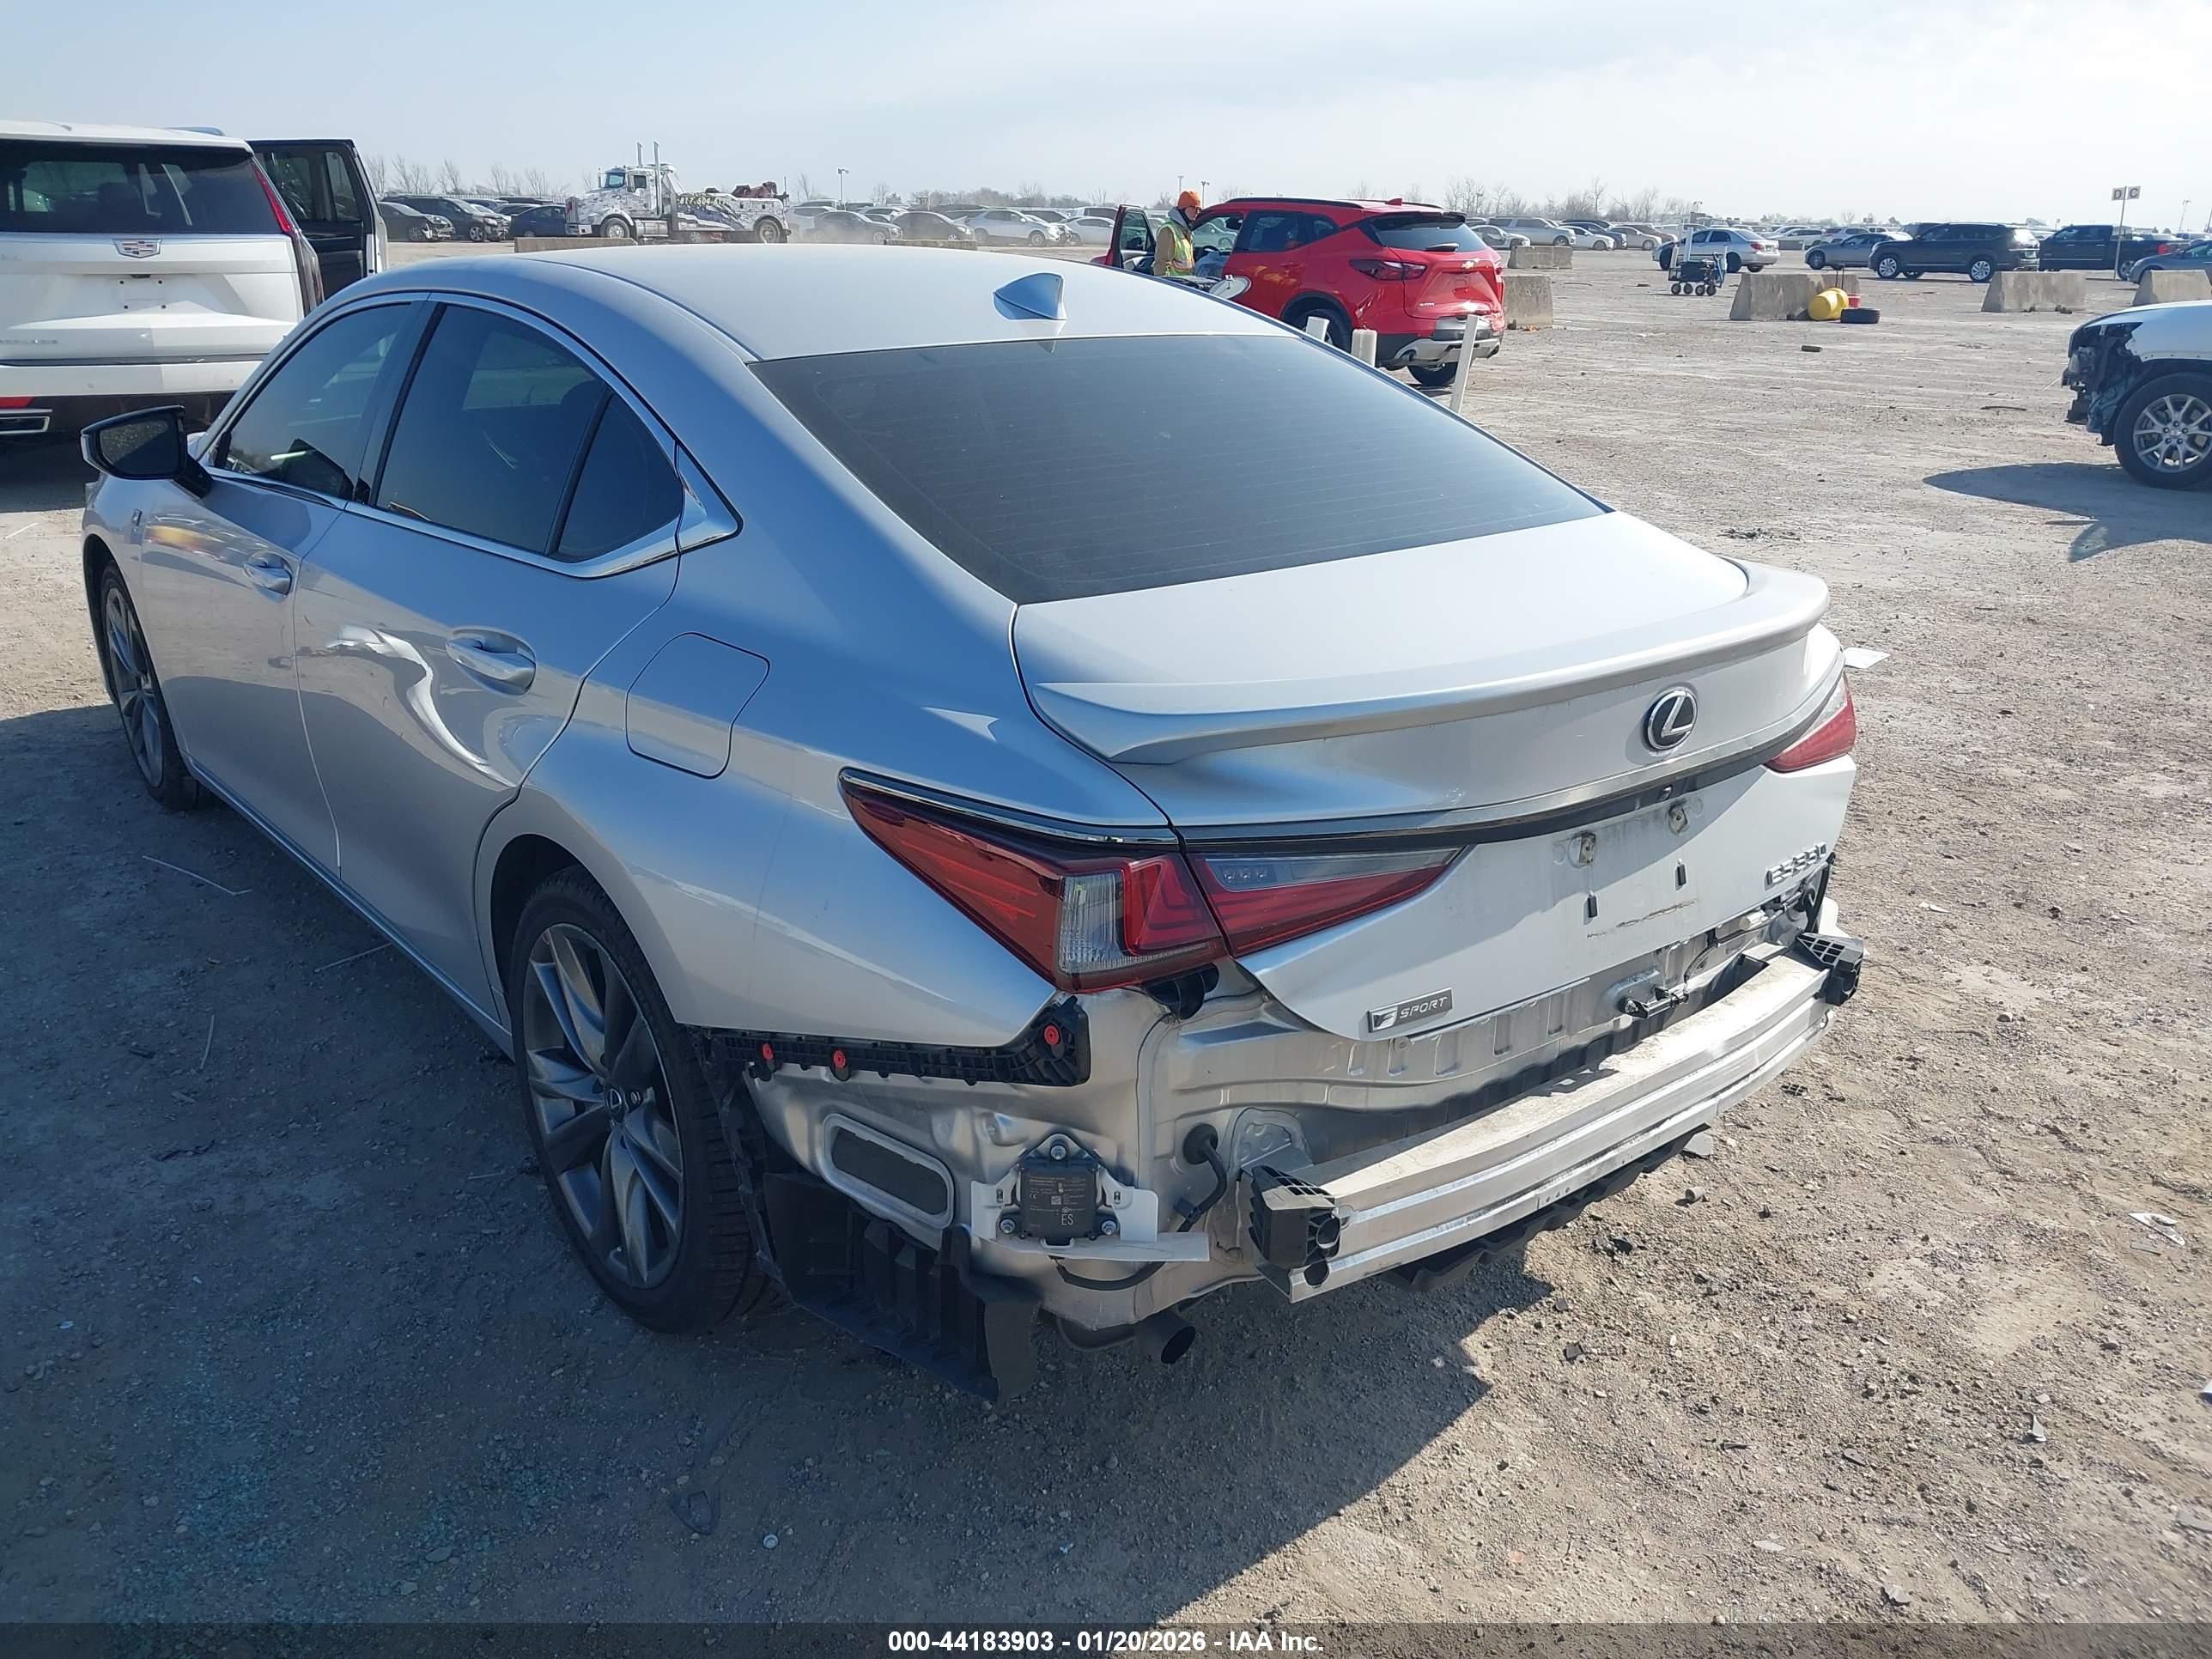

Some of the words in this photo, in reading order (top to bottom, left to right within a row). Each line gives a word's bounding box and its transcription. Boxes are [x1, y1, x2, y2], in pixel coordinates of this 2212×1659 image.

[2114, 189, 2122, 199] D
[2130, 187, 2138, 198] C
[1400, 996, 1448, 1019] SPORT
[1061, 1213, 1073, 1225] ES
